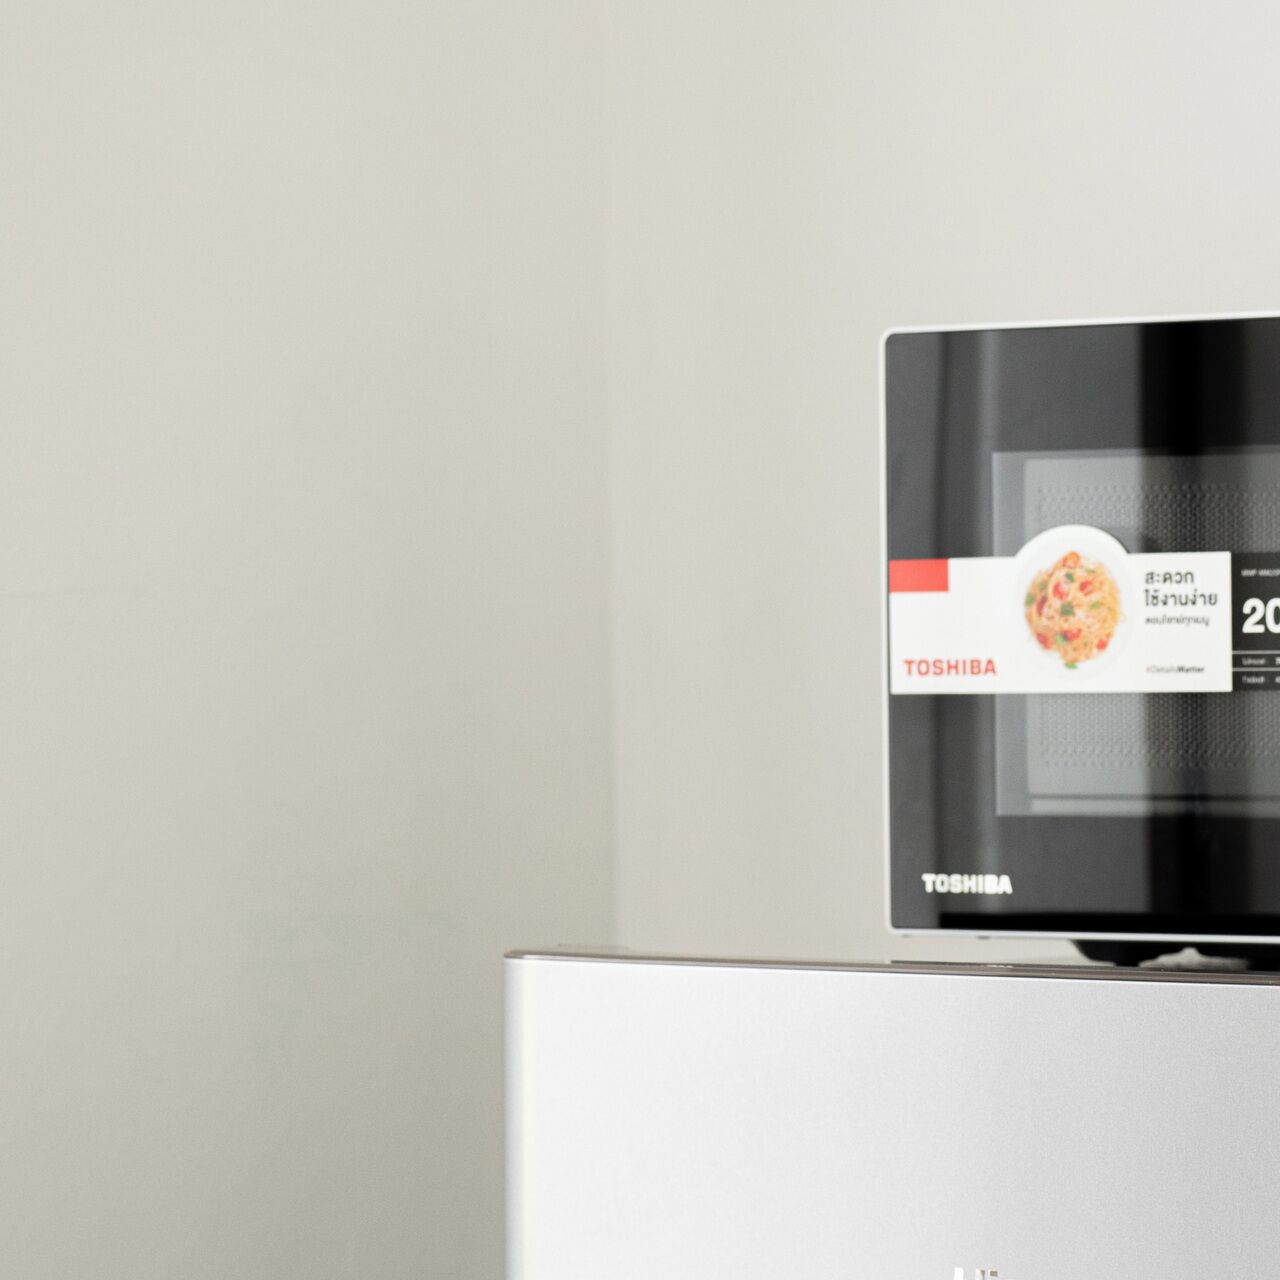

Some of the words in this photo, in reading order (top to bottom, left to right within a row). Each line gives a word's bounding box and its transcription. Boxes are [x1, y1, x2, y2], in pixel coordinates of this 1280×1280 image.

[1144, 571, 1194, 584] สะดวก
[1144, 588, 1218, 606] ใช้งานง่าย
[905, 659, 996, 676] TOSHIBA
[922, 873, 1013, 894] TOSHIBA
